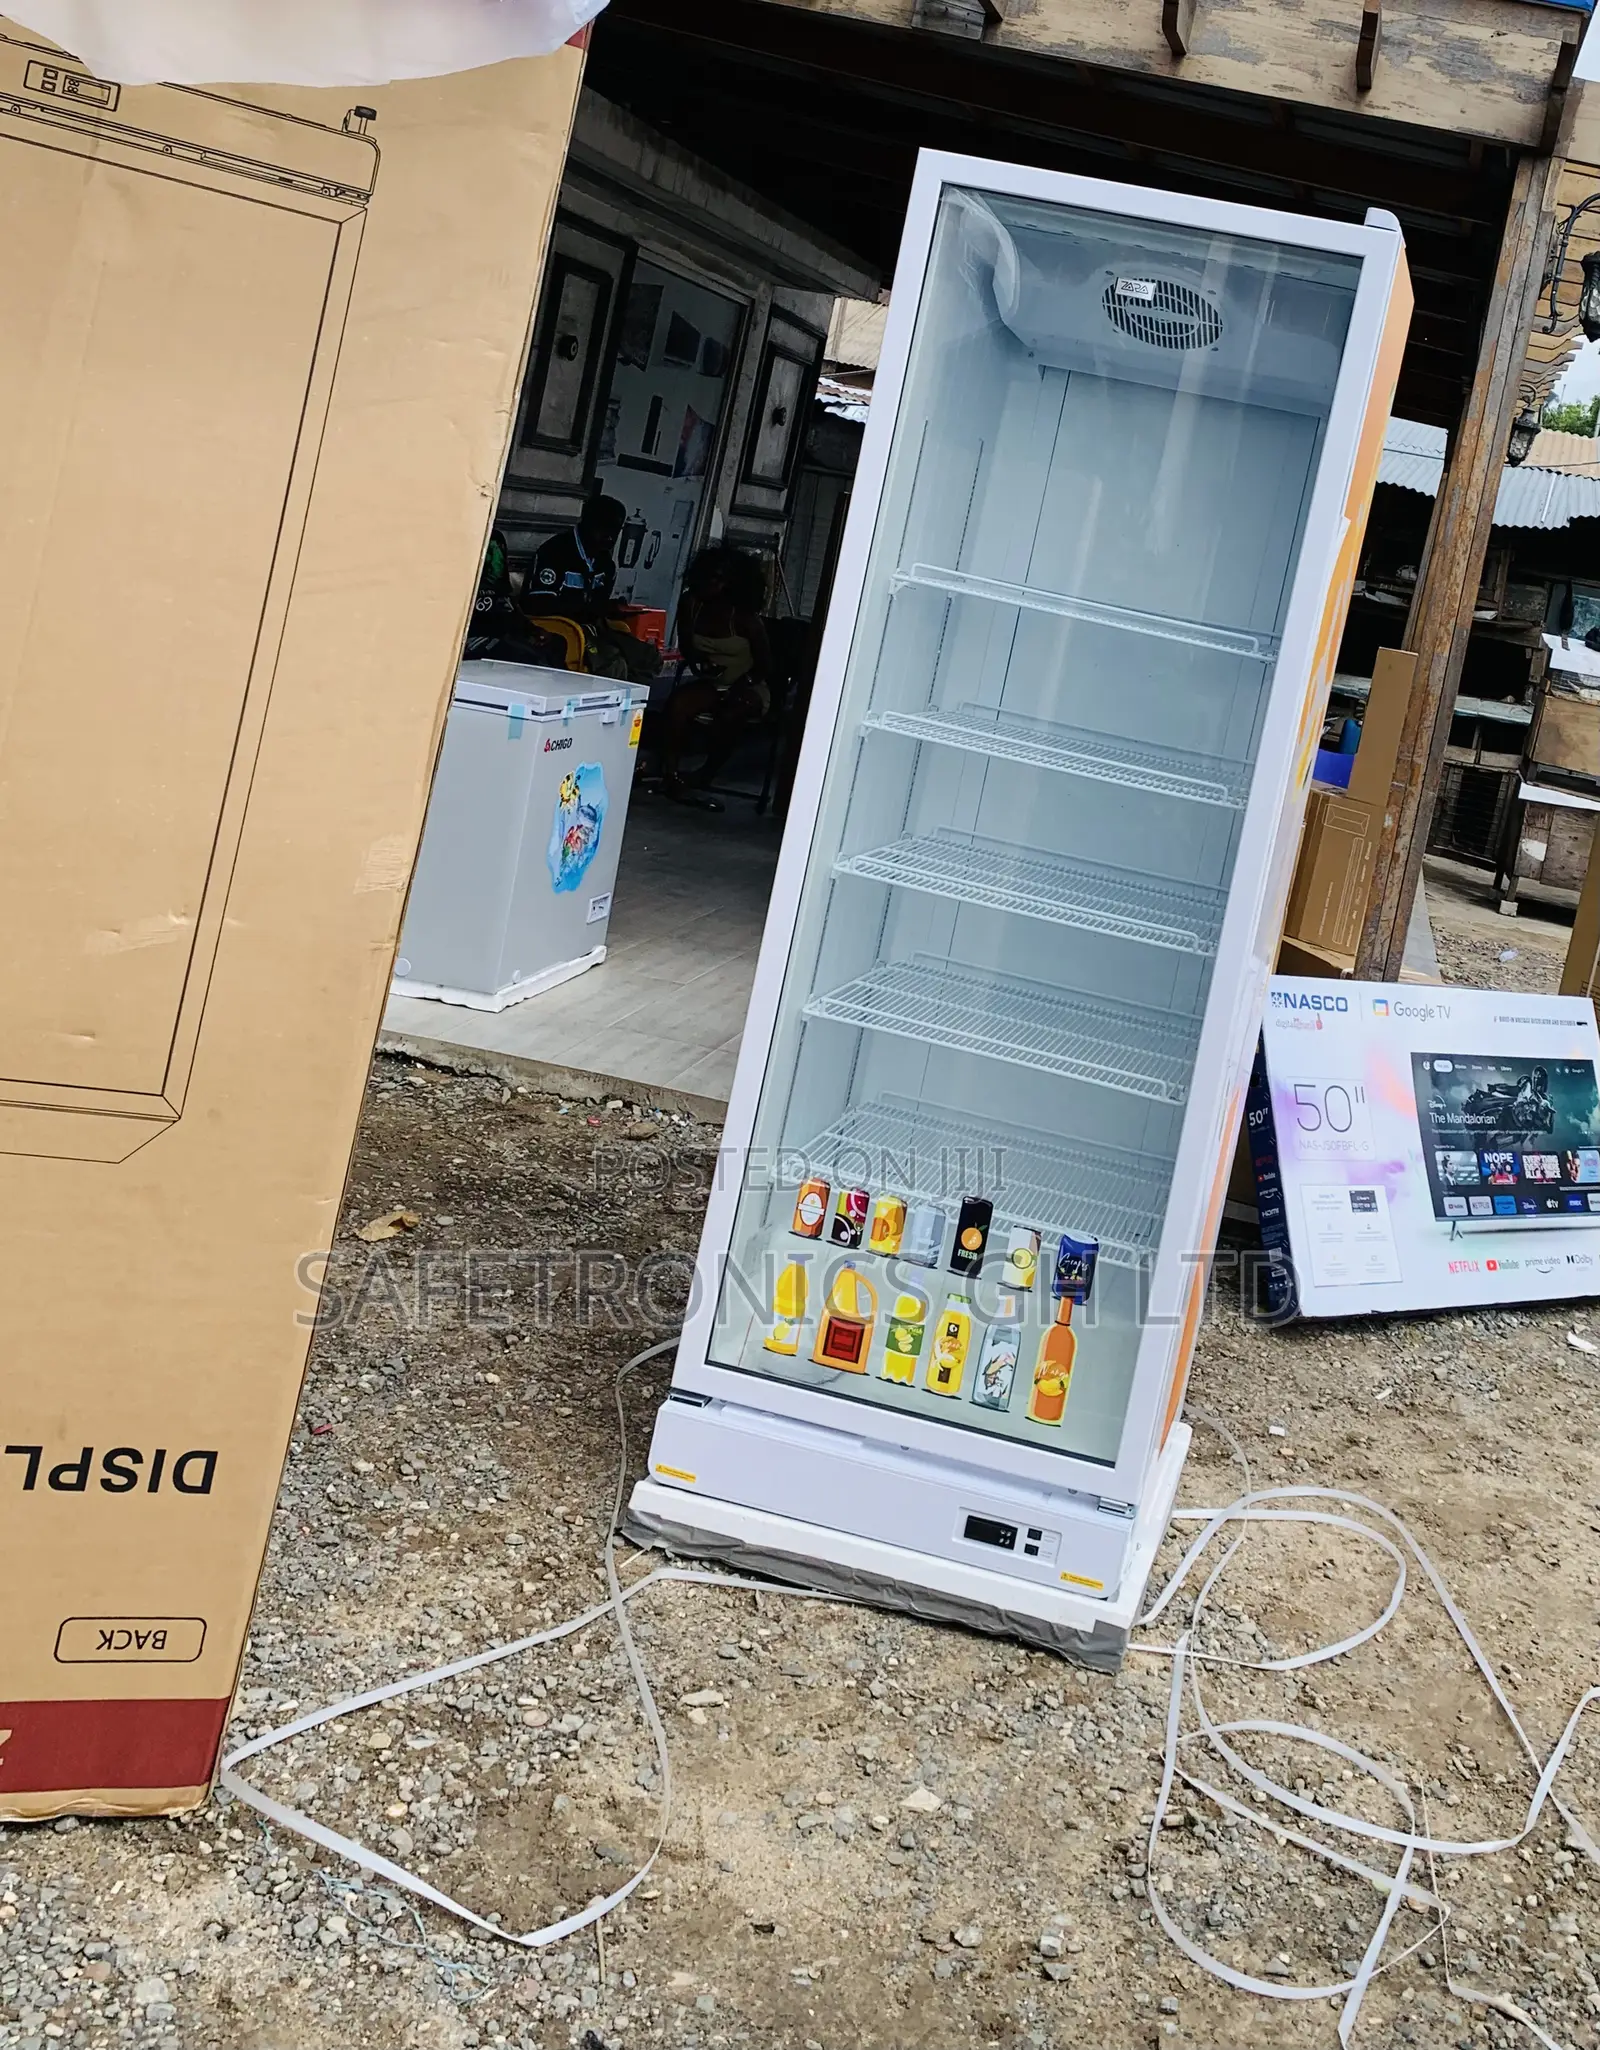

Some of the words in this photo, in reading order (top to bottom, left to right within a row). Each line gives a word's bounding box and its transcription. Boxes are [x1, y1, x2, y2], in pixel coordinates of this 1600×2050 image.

[475, 596, 493, 612] 69
[550, 738, 573, 751] CHIGO
[1283, 993, 1348, 1012] NASCO
[1393, 1001, 1435, 1022] Google
[1436, 1004, 1451, 1019] TV
[1294, 1084, 1365, 1133] 50"
[1249, 1107, 1269, 1126] 50"
[1429, 1112, 1445, 1124] The
[1448, 1113, 1496, 1125] Mandalorian
[1484, 1152, 1514, 1164] NOPE
[957, 1248, 978, 1261] FRESH
[1575, 1255, 1593, 1266] Dolby
[1448, 1261, 1480, 1274] NETFLIX
[1525, 1258, 1543, 1267] prime
[1545, 1257, 1561, 1265] video
[4, 1445, 218, 1494] DISPL
[96, 1629, 168, 1651] BACK
